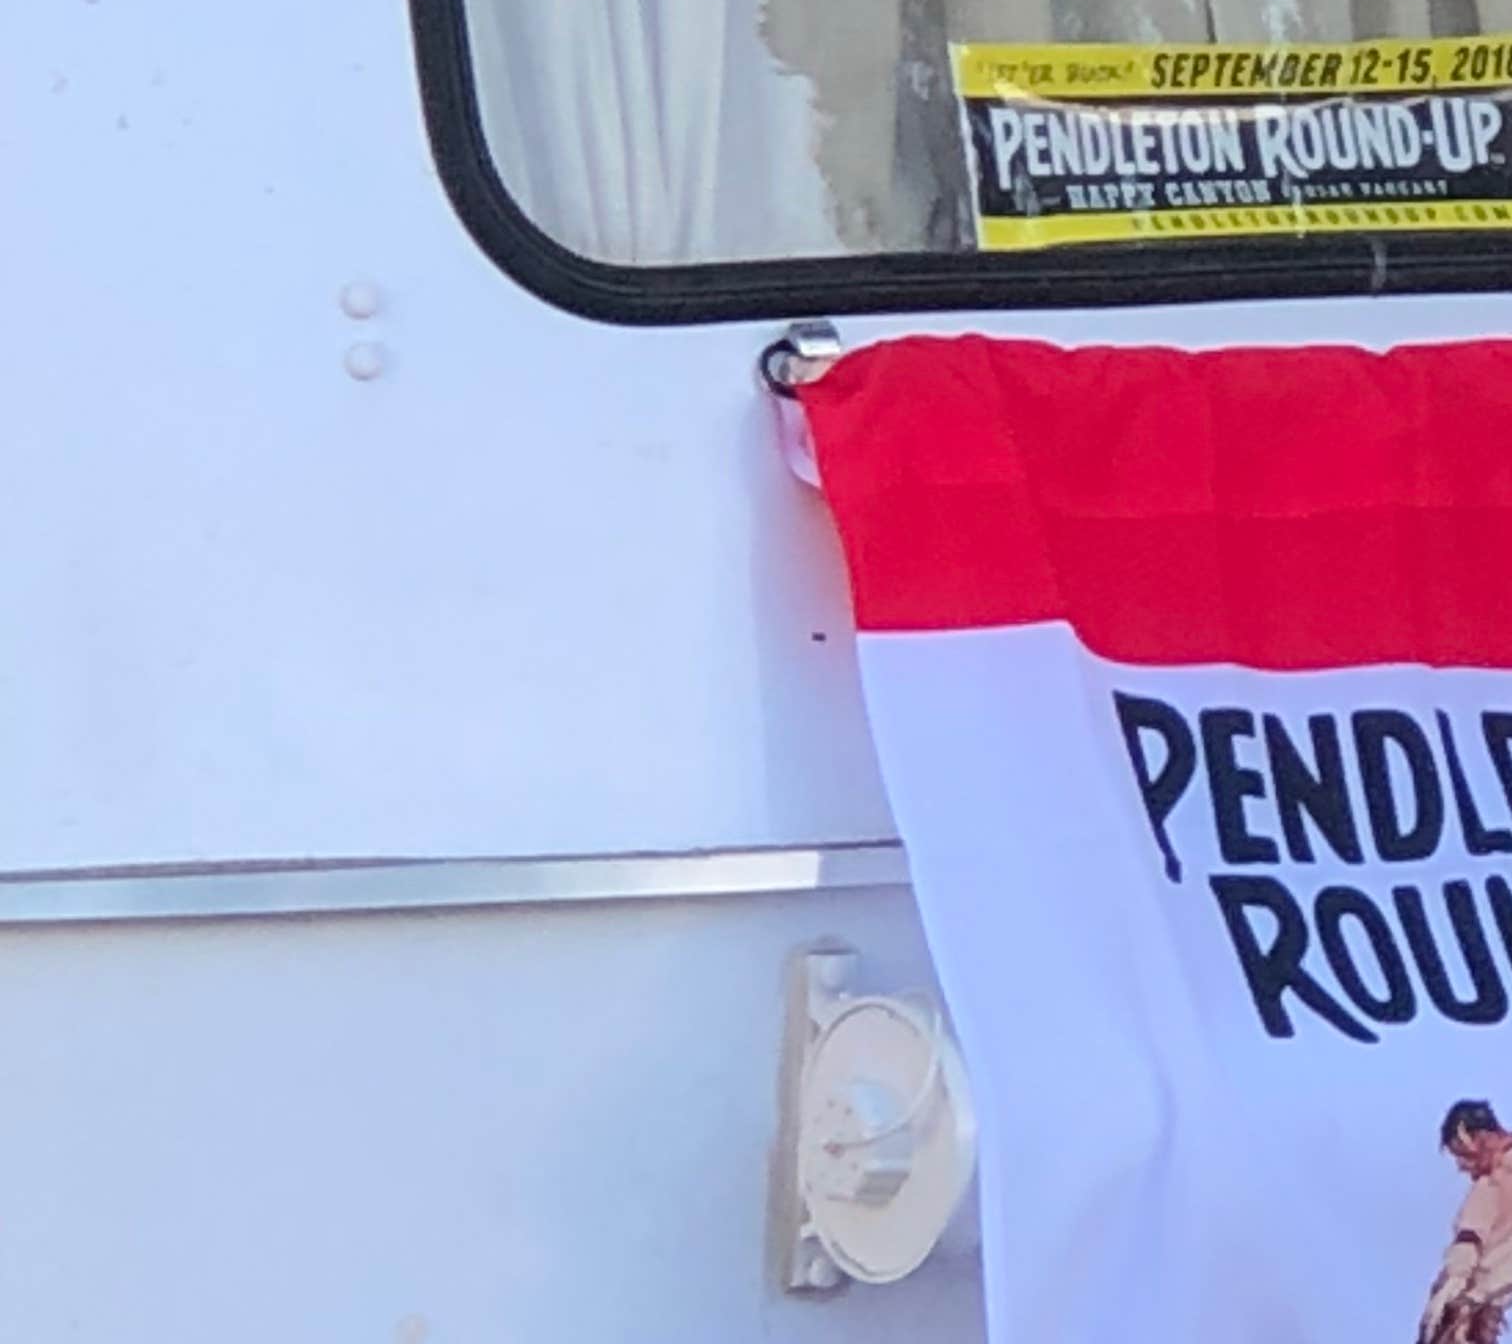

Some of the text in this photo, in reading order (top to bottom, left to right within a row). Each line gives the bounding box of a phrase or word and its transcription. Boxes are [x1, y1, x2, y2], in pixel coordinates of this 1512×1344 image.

[1150, 53, 1342, 89] SEPTEMBER
[989, 107, 1248, 191] PENDLETON
[1164, 178, 1271, 206] CANYON
